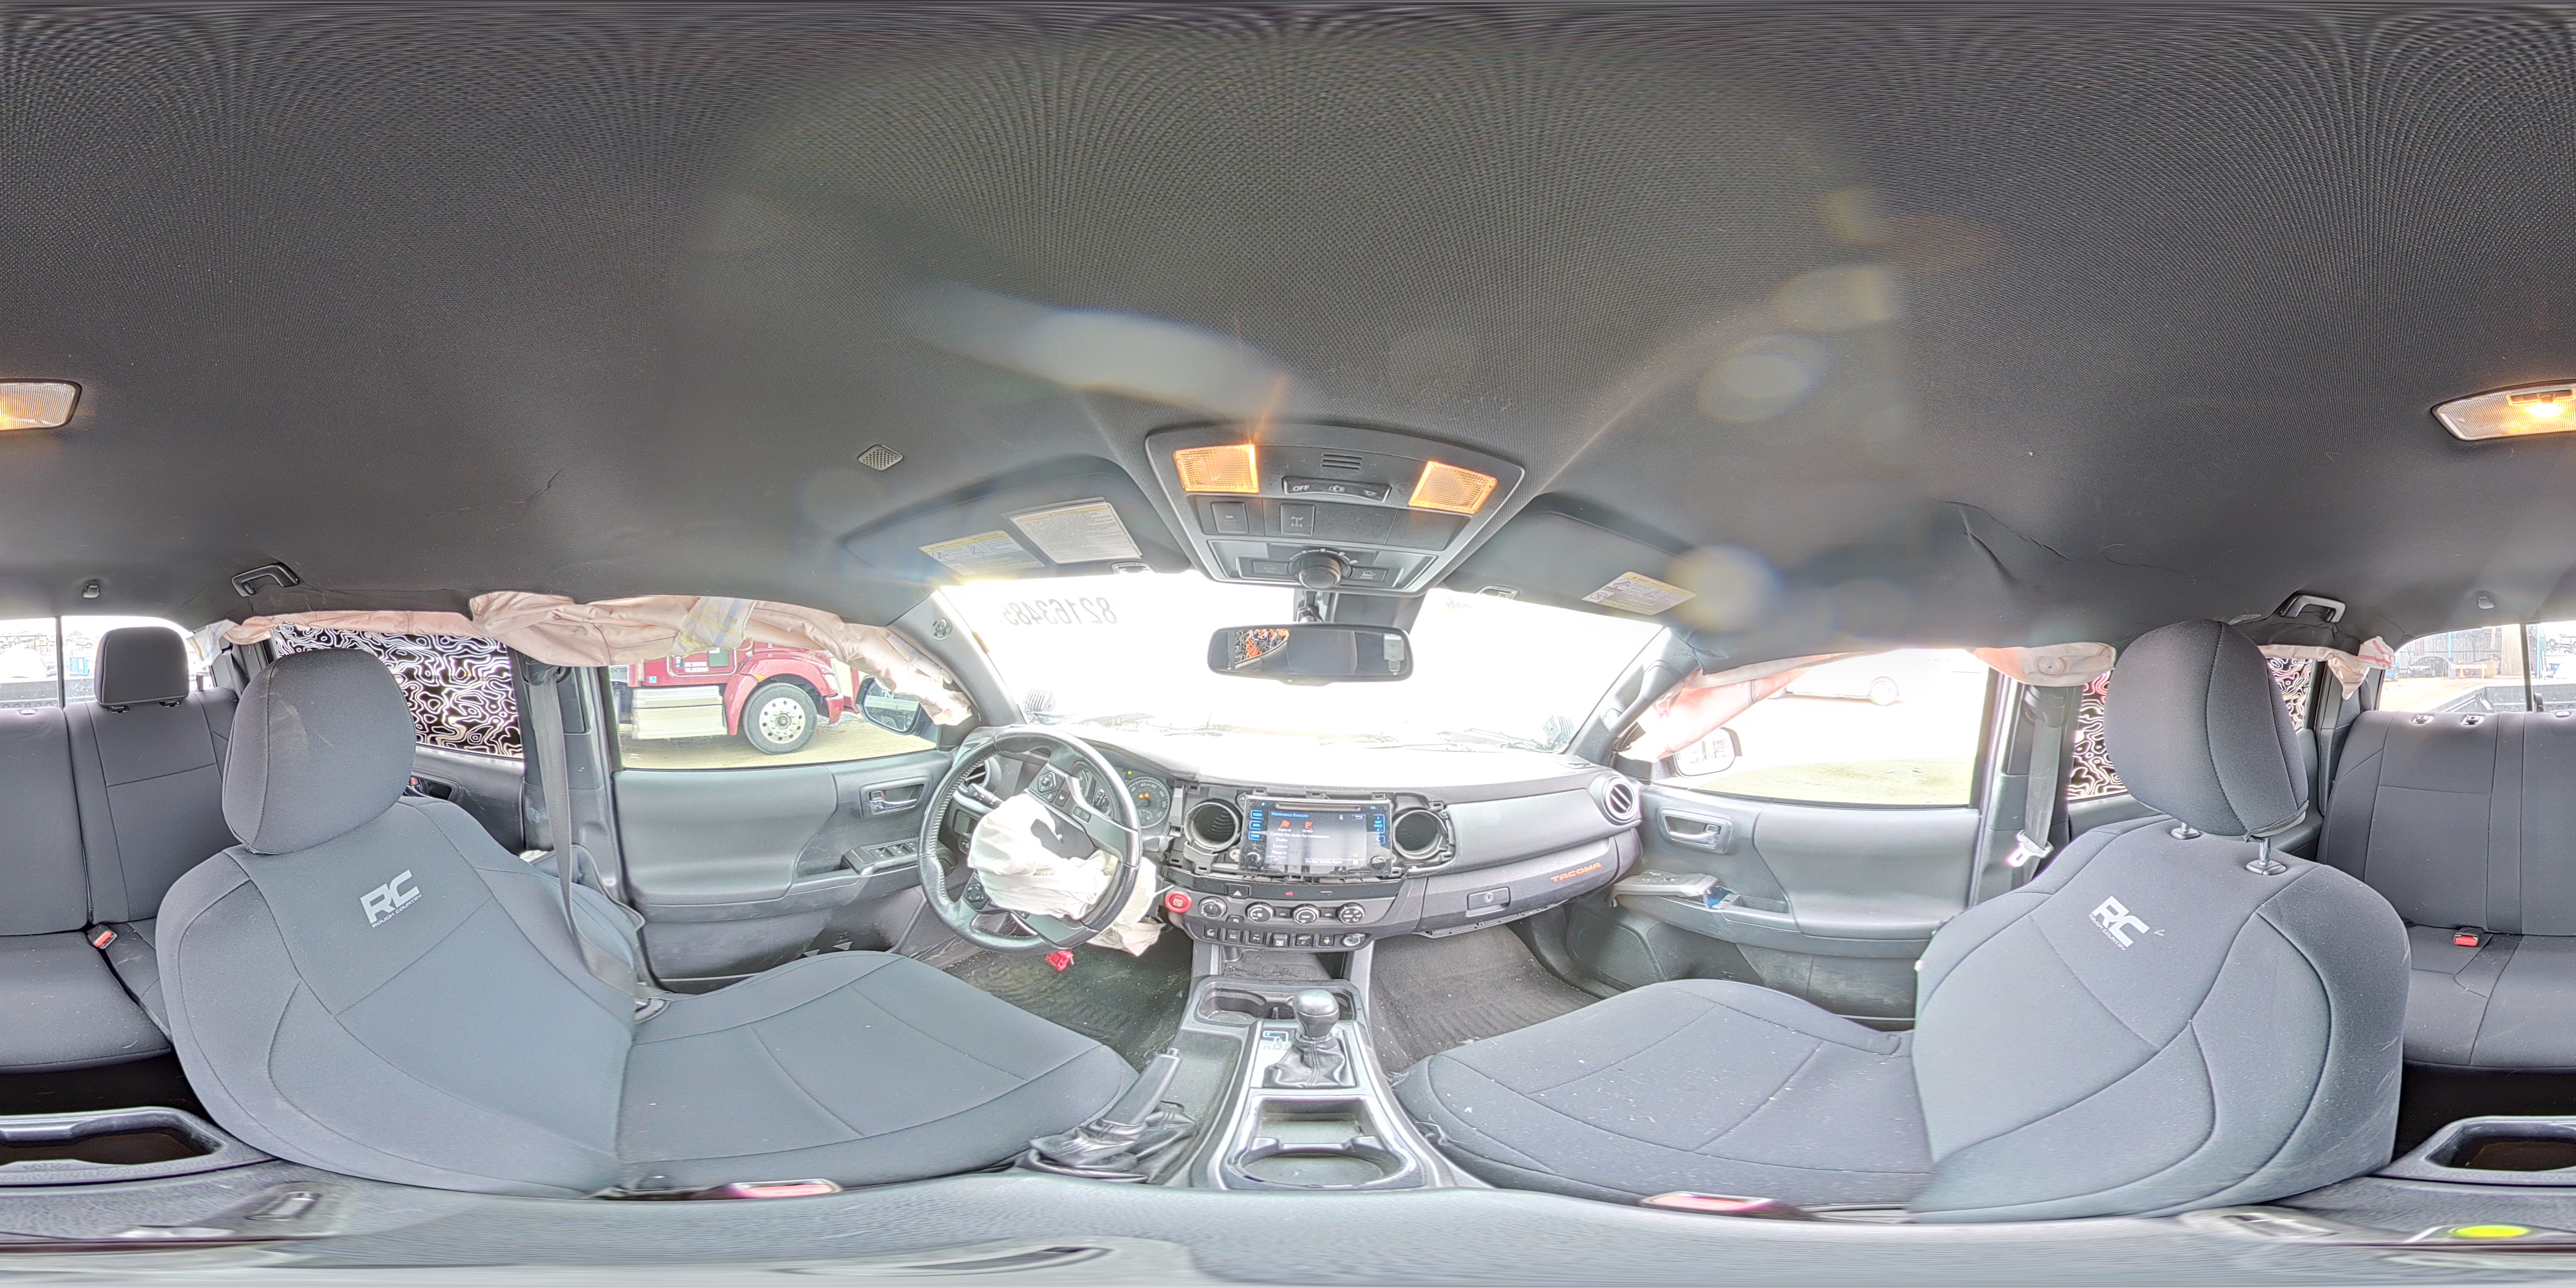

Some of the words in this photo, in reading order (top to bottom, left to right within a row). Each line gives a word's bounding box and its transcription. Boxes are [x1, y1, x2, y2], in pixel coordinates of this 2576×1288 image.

[1550, 863, 1602, 882] TACOMA
[360, 869, 420, 924] RC
[372, 913, 395, 928] ROUGH
[395, 893, 422, 914] COUNTRY
[2088, 914, 2103, 929] ROUGH
[2102, 929, 2127, 951] COUNTRY
[2091, 895, 2151, 948] RC
